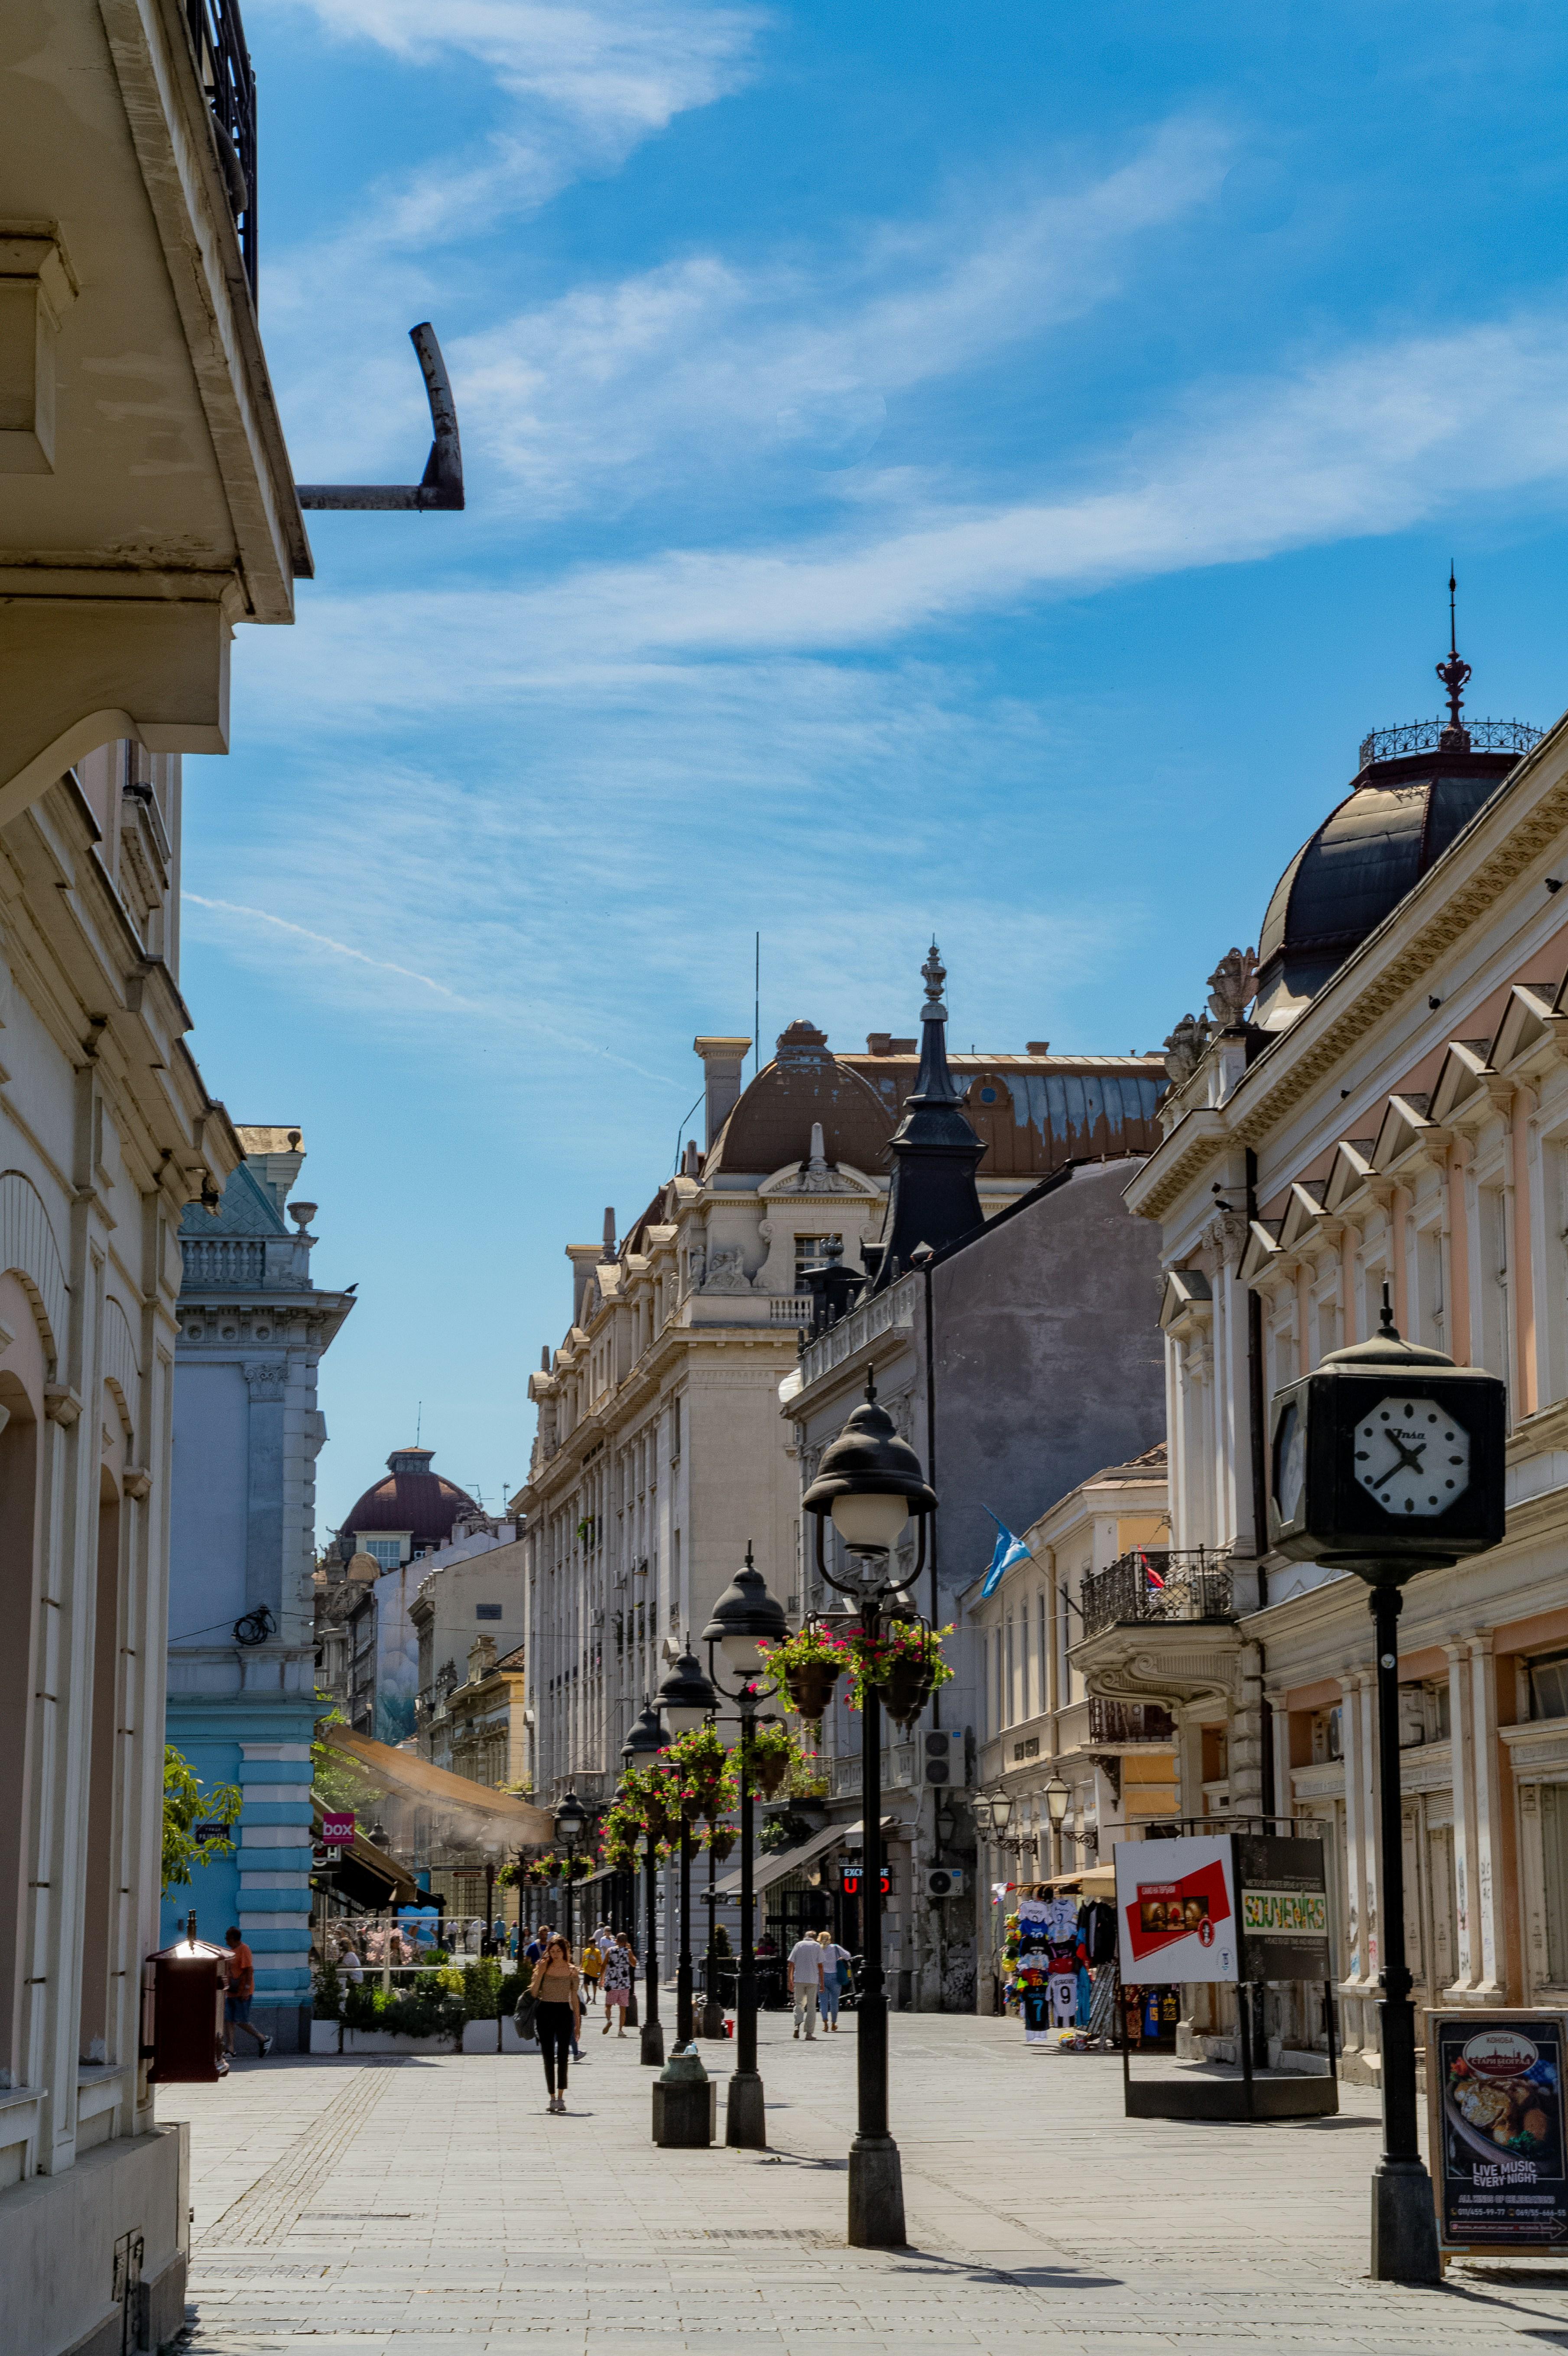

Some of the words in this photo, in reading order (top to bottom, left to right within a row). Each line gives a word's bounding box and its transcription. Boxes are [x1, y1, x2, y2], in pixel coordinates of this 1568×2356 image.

[323, 1821, 353, 1836] box
[844, 1878, 890, 1894] UD
[1245, 1895, 1324, 1929] SOUVENIRS
[1060, 1986, 1071, 2004] 9
[1032, 2000, 1043, 2021] 7
[1473, 2163, 1497, 2176] LIVE
[1501, 2160, 1536, 2174] MUSIC
[1474, 2175, 1505, 2187] EVERY
[1507, 2173, 1538, 2184] NIGHT
[1458, 2195, 1472, 2203] ALL
